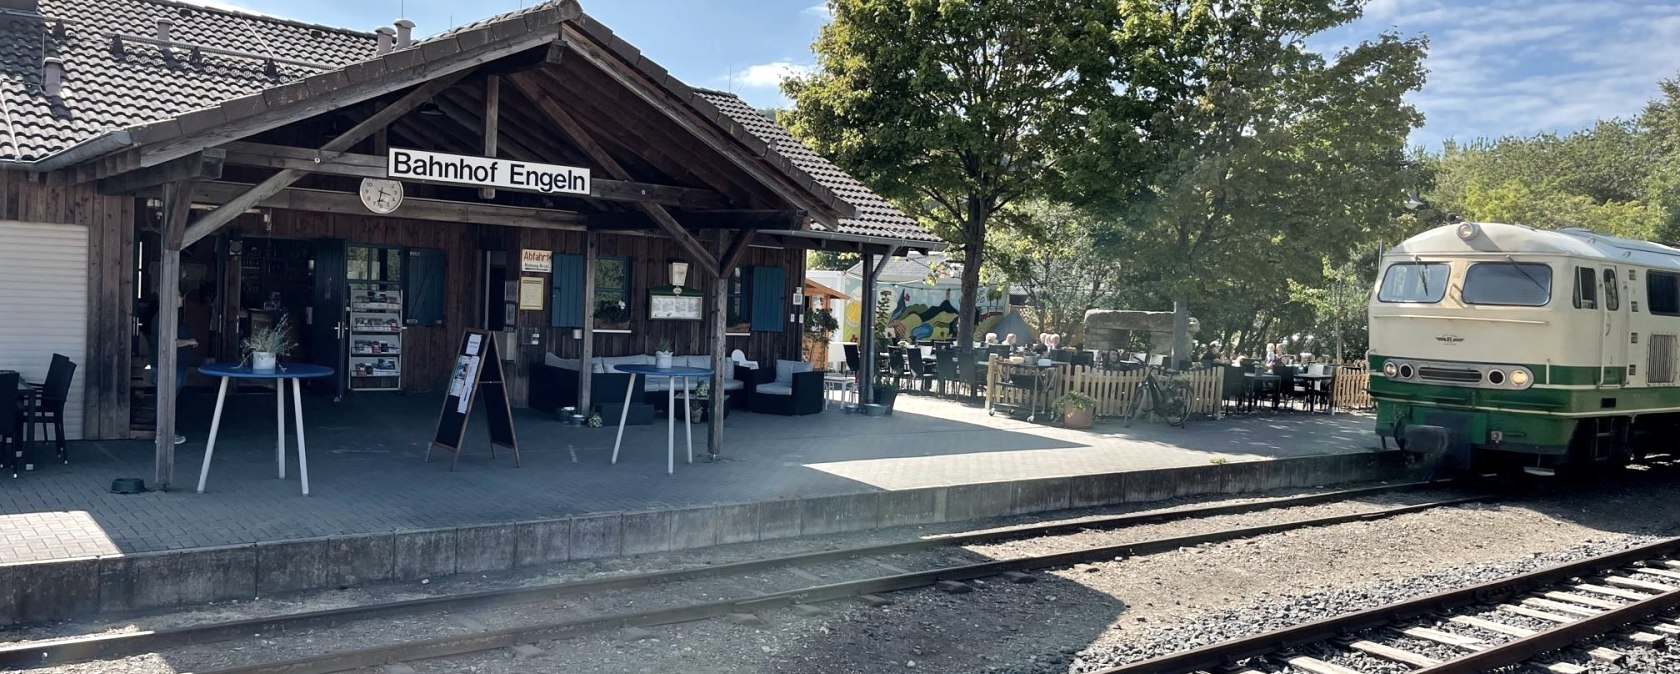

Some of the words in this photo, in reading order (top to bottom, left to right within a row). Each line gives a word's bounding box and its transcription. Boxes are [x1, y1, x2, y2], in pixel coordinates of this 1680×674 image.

[394, 151, 498, 183] Bahnhof
[510, 163, 585, 192] Engeln
[523, 250, 550, 262] Abfahrt
